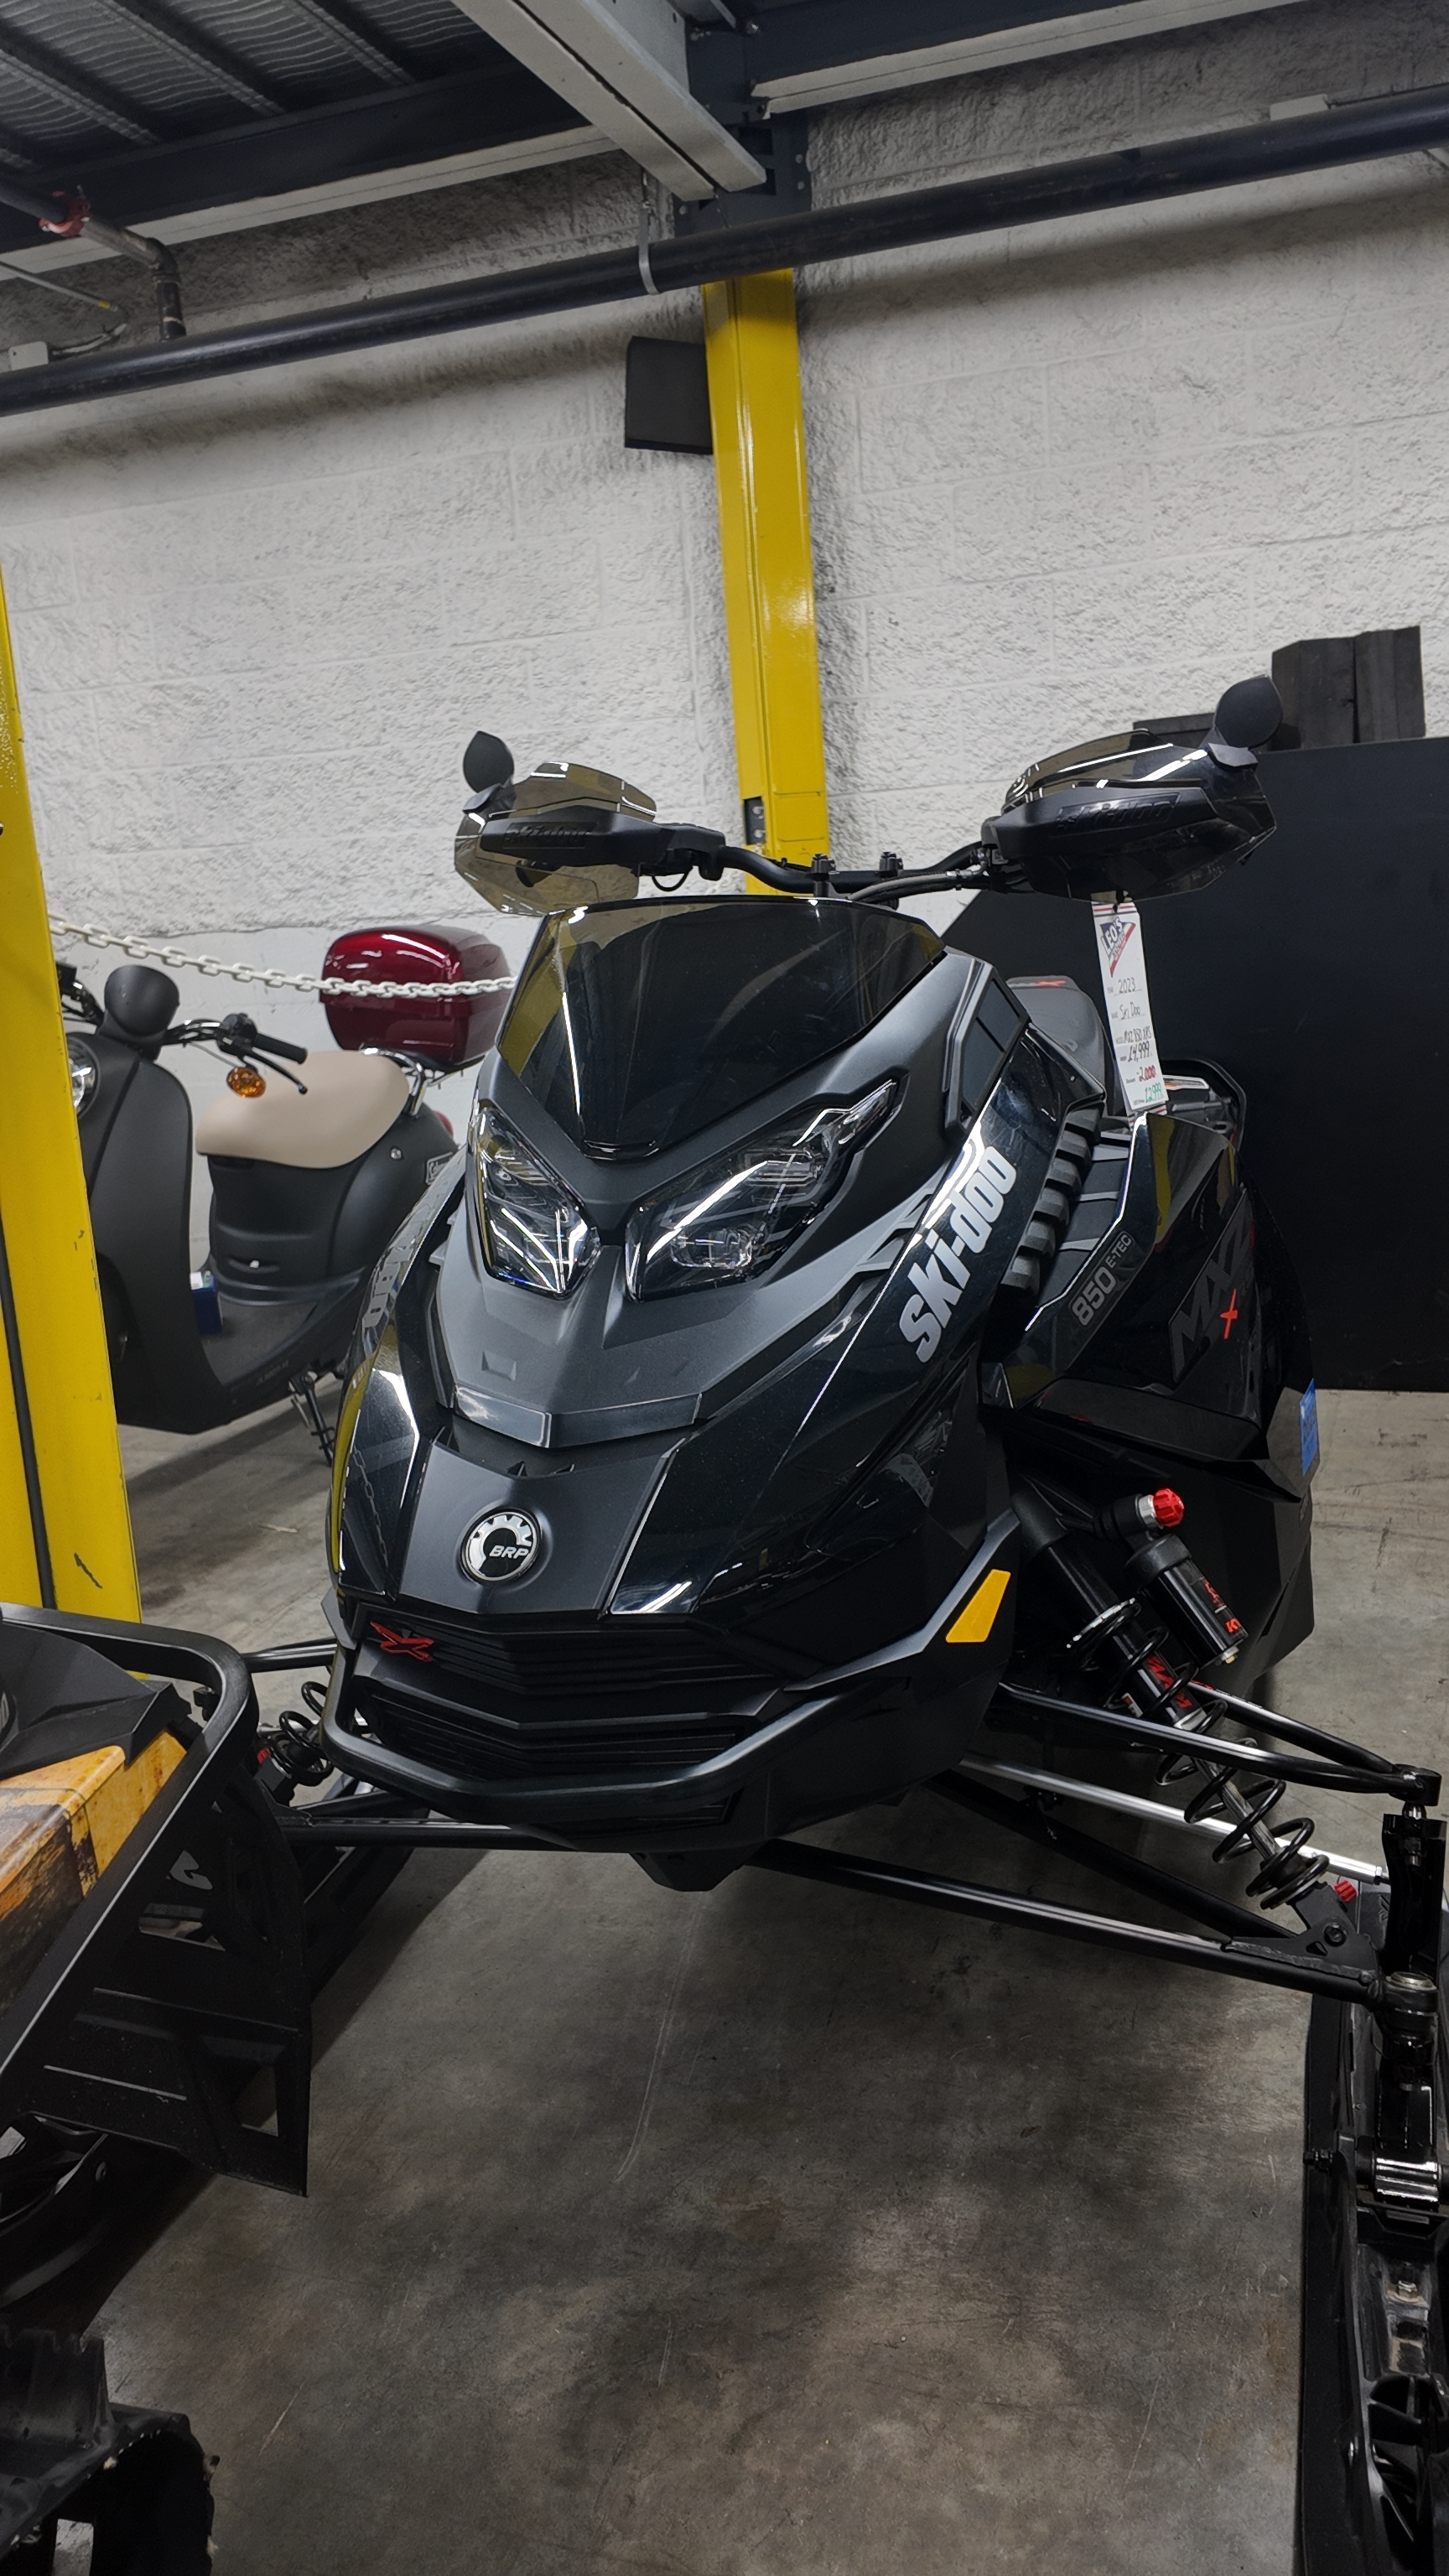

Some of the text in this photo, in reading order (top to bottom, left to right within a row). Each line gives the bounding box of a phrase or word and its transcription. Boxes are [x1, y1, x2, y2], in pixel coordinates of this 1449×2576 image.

[1100, 917, 1123, 958] LEO'S
[1118, 977, 1136, 994] 2023
[1072, 1234, 1132, 1326] 850 E-TEC
[489, 1545, 530, 1559] BRP
